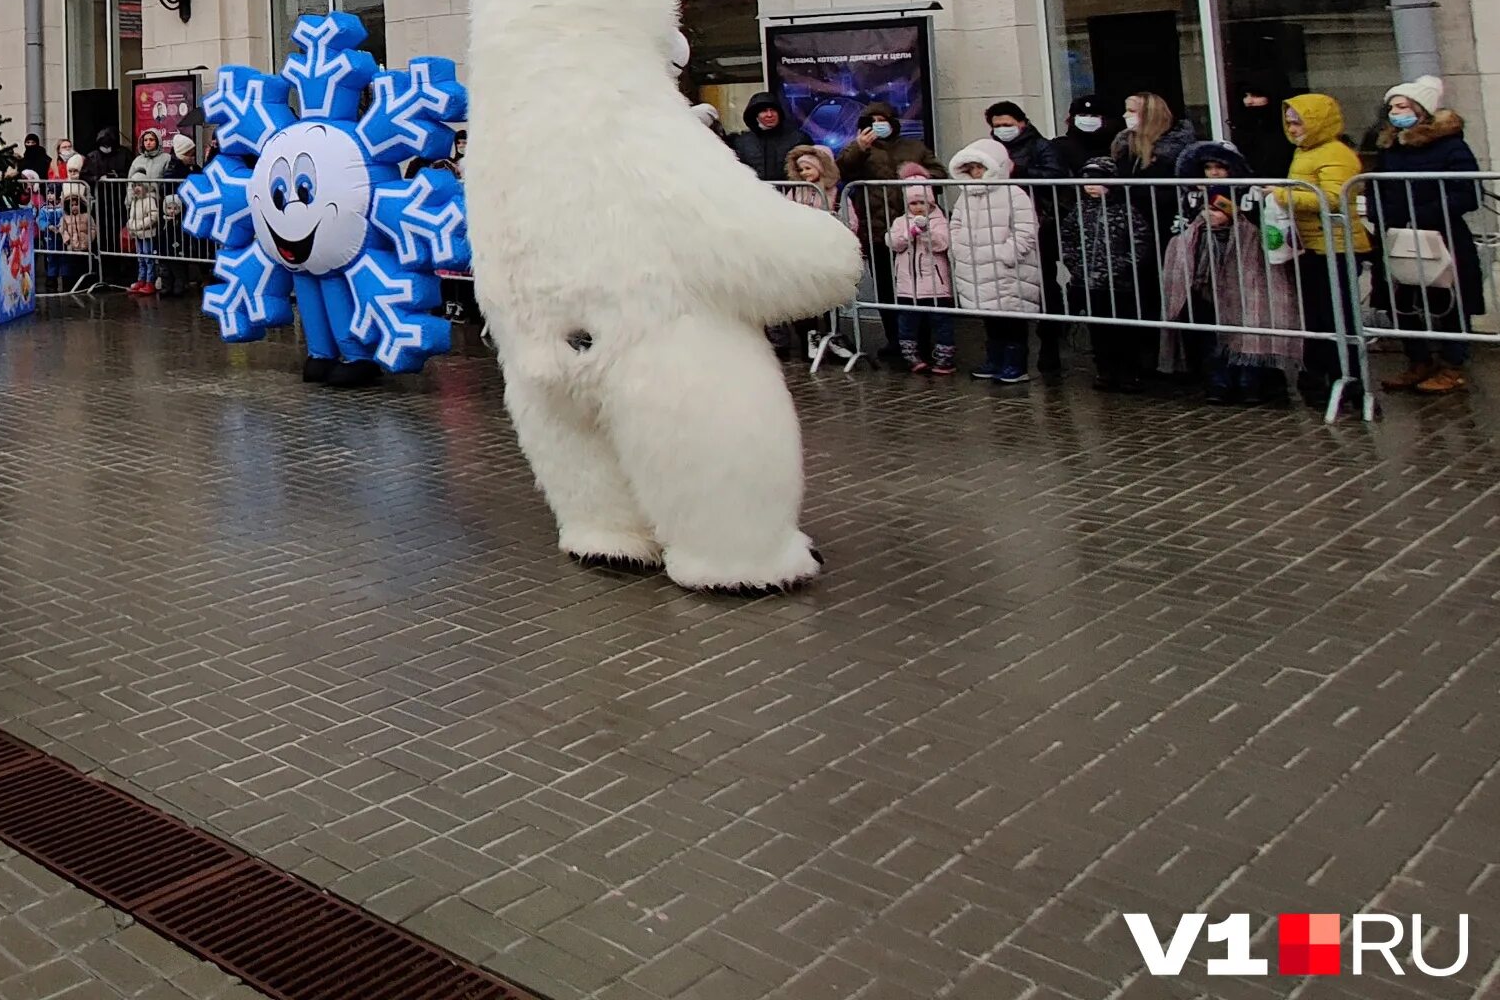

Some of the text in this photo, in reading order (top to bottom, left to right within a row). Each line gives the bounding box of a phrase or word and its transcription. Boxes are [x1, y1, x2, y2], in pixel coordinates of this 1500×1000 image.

[782, 56, 816, 65] Реклама,
[817, 55, 847, 63] которая
[849, 53, 881, 62] двигает
[890, 52, 911, 60] цели
